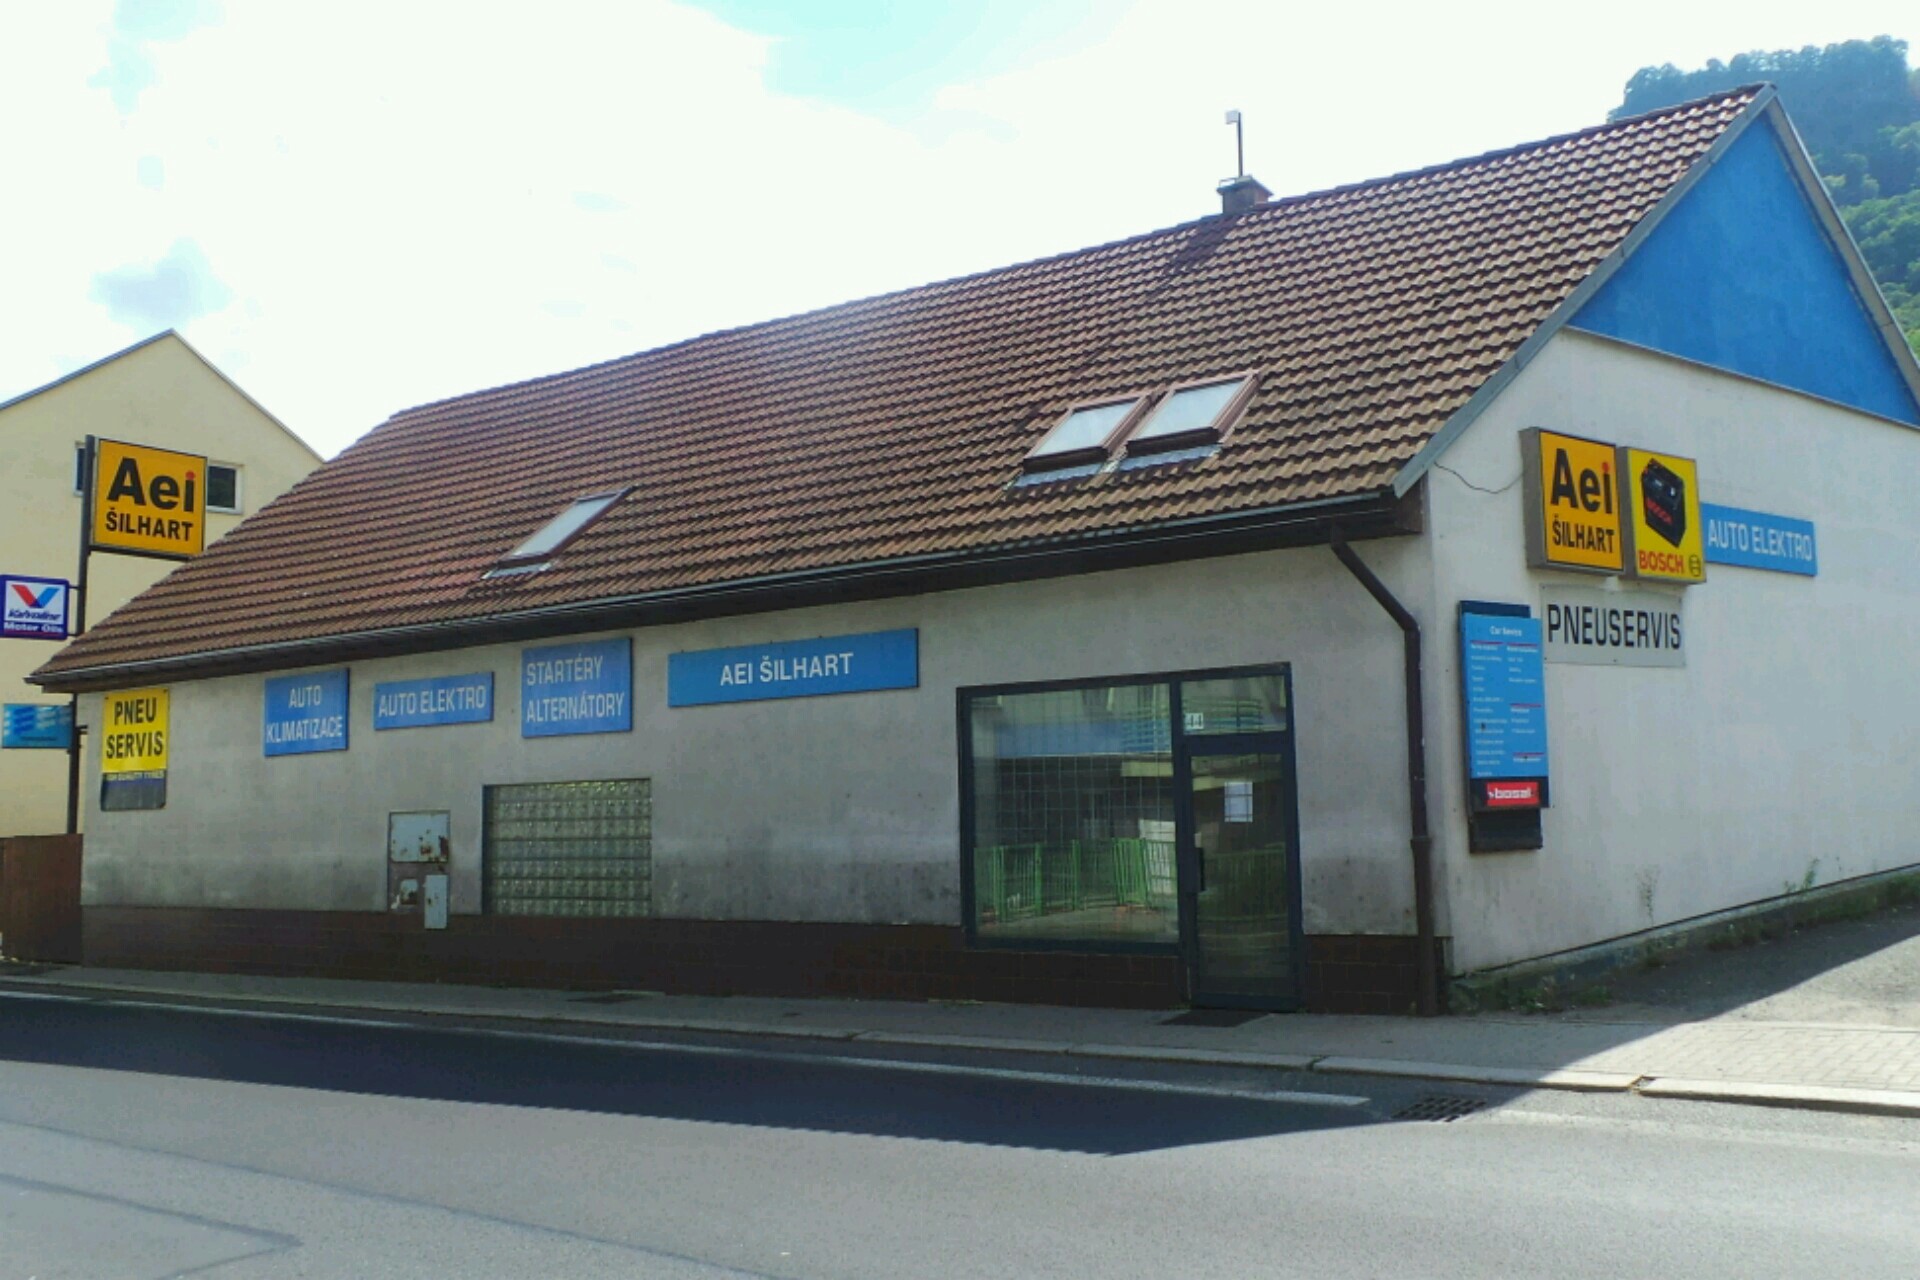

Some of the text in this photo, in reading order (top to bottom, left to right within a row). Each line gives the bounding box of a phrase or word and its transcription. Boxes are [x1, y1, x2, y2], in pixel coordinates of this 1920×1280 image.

[106, 456, 196, 513] Aei
[1550, 448, 1614, 514] Aei
[105, 507, 194, 541] ŠILHART
[1552, 514, 1615, 554] ŠILHART
[1707, 518, 1813, 562] AUTO ELEKTRO
[1638, 549, 1685, 575] BOSCH
[1547, 604, 1681, 649] PNEUSERVIS
[526, 653, 604, 686] STARTÉRY
[720, 652, 855, 687] AEI ŠILHART
[114, 697, 157, 726] PNEU
[288, 684, 323, 709] AUTO
[377, 684, 487, 718] AUTO ELEKTRO
[526, 690, 626, 723] ALTERNÁTORY
[106, 731, 164, 759] SERVIS
[266, 716, 344, 744] KLIMATIZACE
